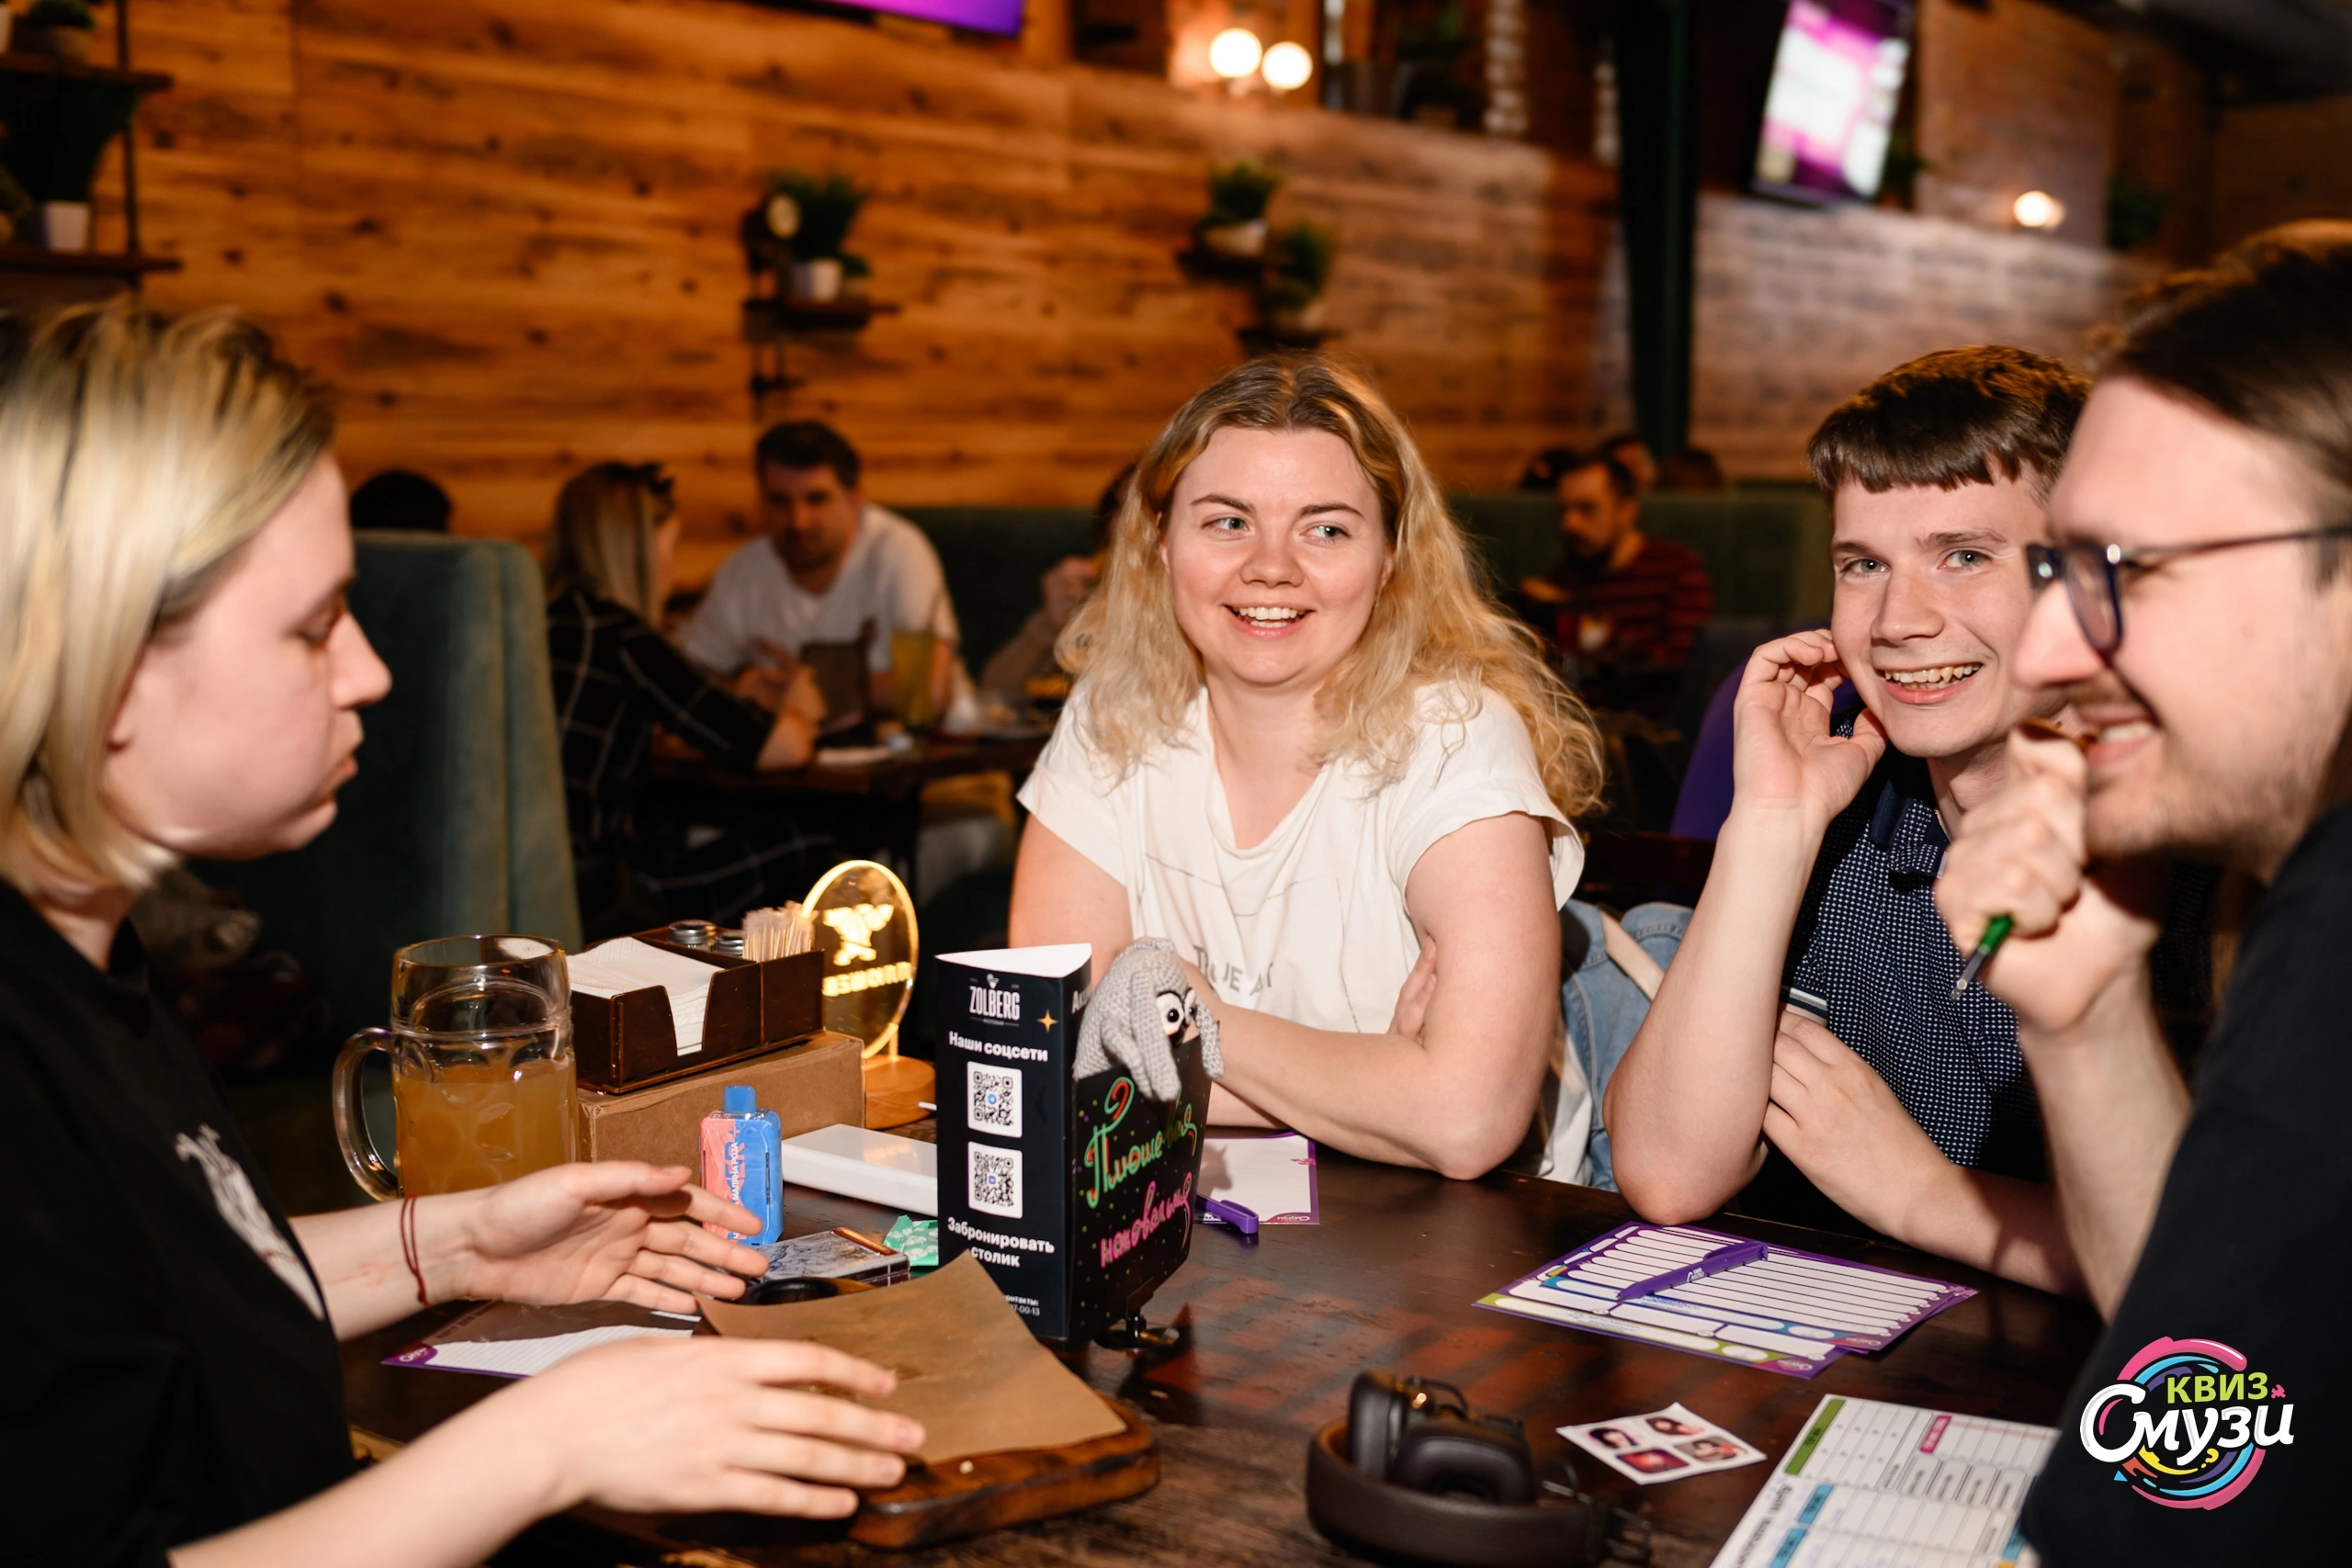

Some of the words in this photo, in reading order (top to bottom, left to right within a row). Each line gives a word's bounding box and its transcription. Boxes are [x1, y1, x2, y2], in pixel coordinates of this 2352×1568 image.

[968, 986, 1020, 1021] ZOLBERG
[948, 1031, 982, 1053] Наши
[984, 1042, 1048, 1062] соцсети
[947, 1216, 1055, 1254] Забронировать
[971, 1247, 1021, 1268] столик
